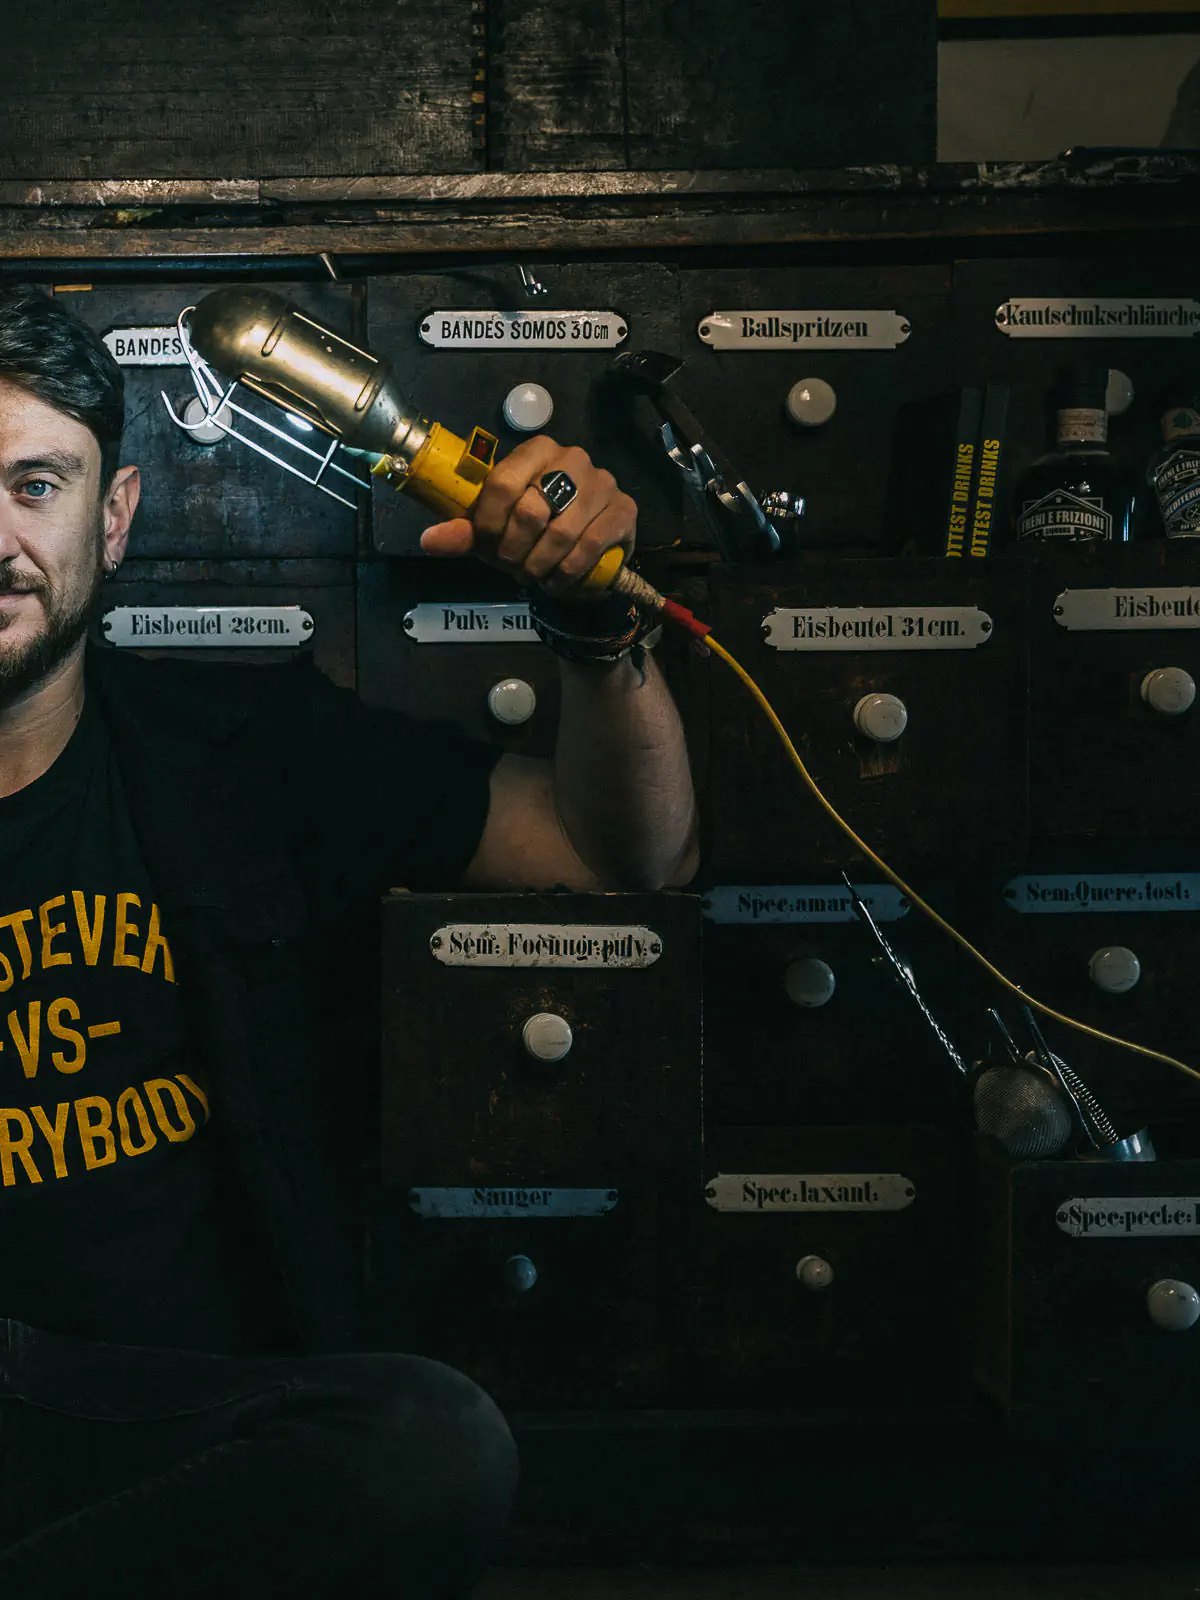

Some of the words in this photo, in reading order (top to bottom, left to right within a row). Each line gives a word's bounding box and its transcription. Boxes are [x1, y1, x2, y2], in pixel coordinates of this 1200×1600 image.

[441, 320, 505, 340] BANDES
[510, 320, 567, 340] SOMOS
[740, 316, 869, 343] Ballspritzen
[115, 337, 182, 357] BANDES
[952, 443, 975, 502] DRINKS
[978, 439, 1000, 498] DRINKS
[1047, 512, 1055, 524] E
[1055, 509, 1105, 531] FRIZIONI
[130, 613, 223, 636] Eisbeutel
[791, 615, 894, 639] Eisbeutel
[901, 616, 966, 638] 31cm.
